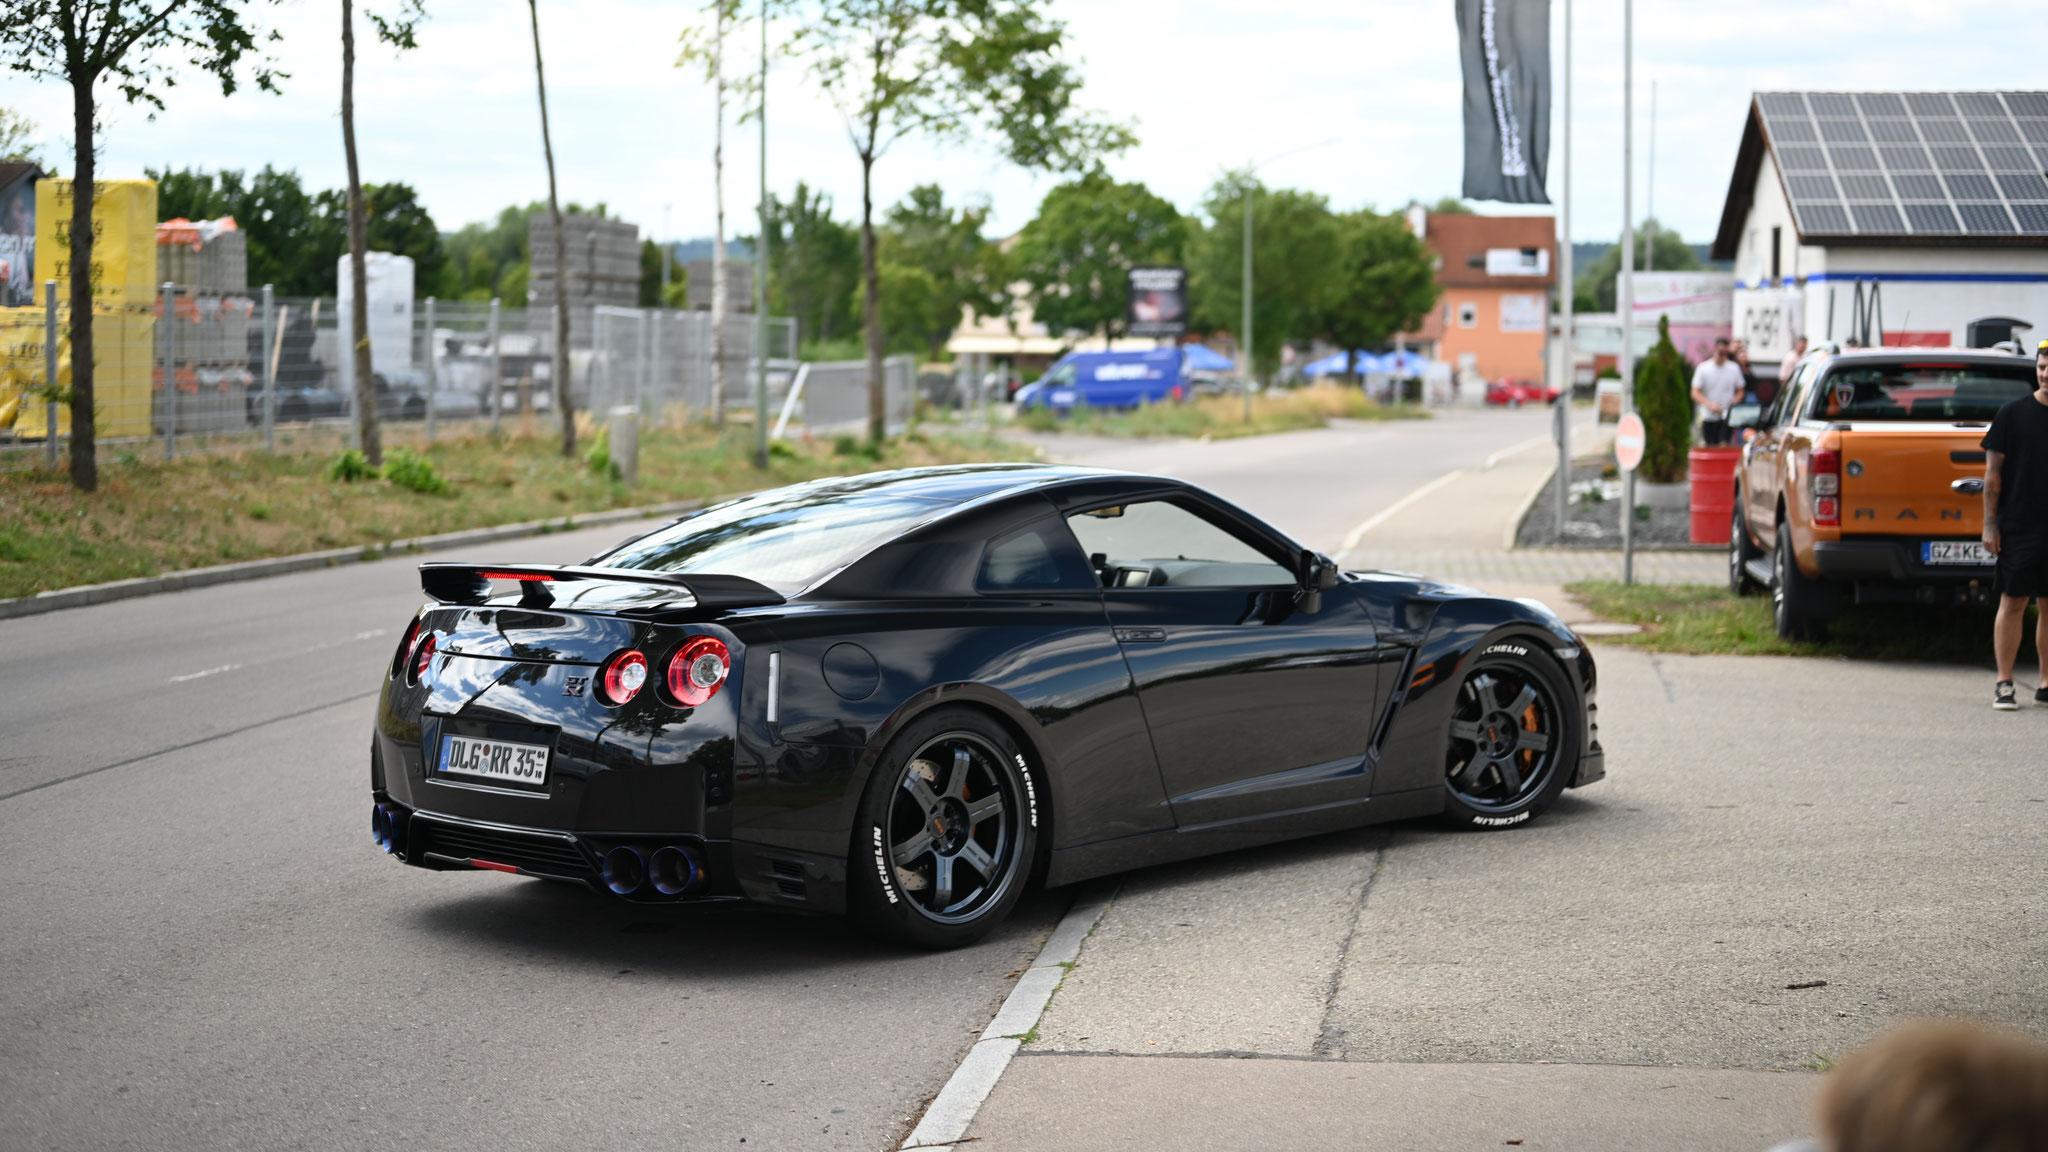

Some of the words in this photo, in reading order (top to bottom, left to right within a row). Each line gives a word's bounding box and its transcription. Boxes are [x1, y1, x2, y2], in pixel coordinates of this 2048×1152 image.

[1854, 508, 1962, 520] RAN
[1931, 545, 1952, 559] GZ
[1962, 545, 1983, 559] KE
[449, 740, 482, 770] DLG
[489, 745, 513, 775] RR
[513, 748, 537, 777] 35
[1015, 753, 1037, 827] MICHELIN
[1472, 810, 1530, 826] MICHELIN
[873, 826, 899, 904] MICHELIN
